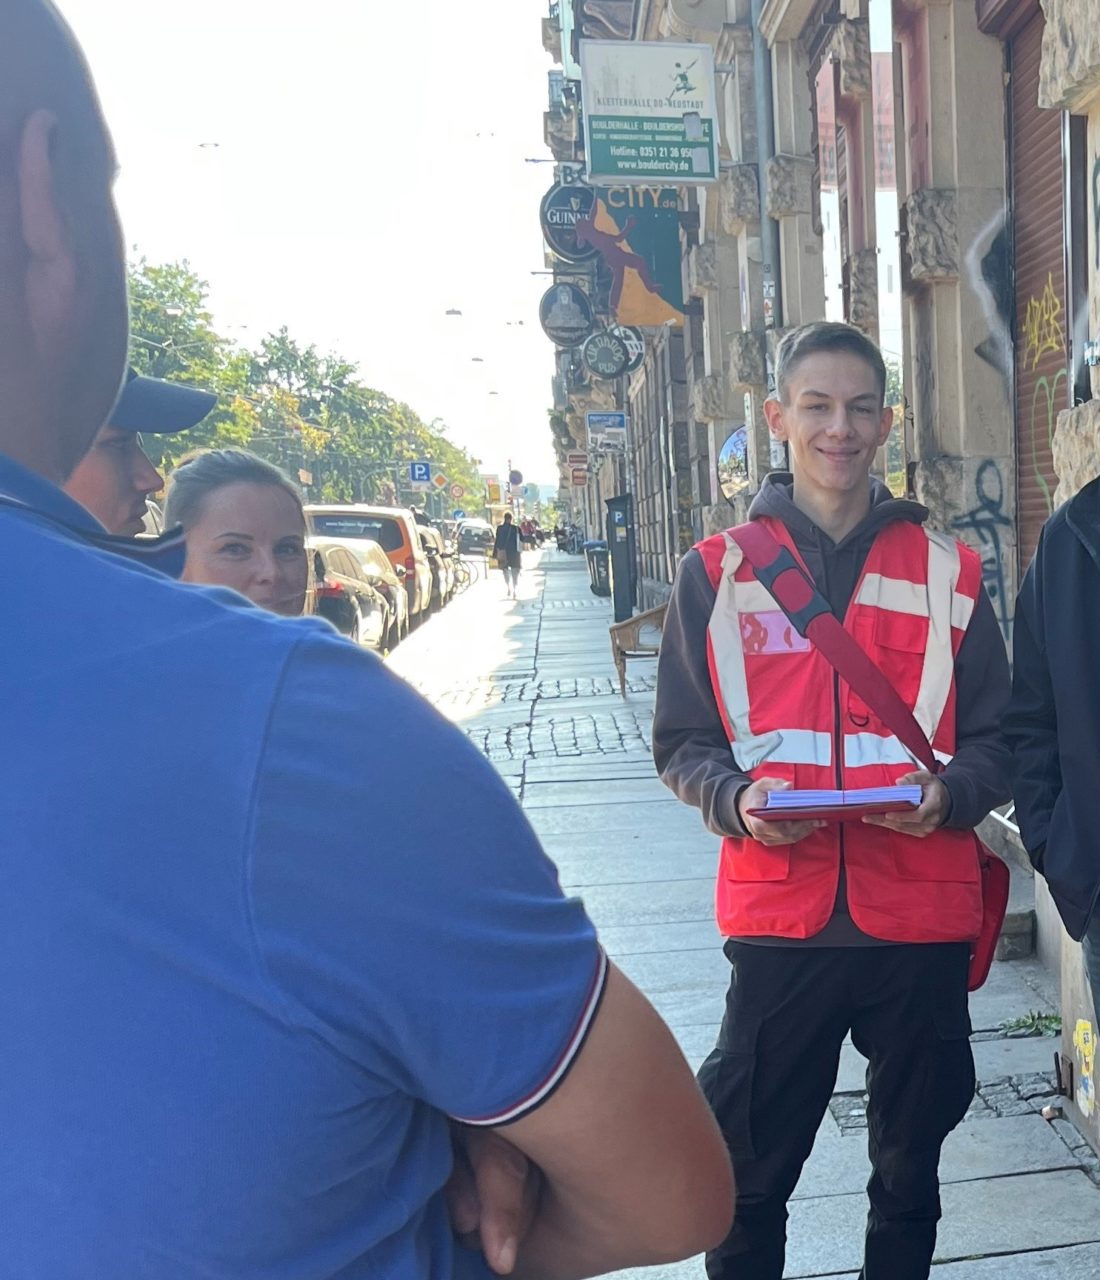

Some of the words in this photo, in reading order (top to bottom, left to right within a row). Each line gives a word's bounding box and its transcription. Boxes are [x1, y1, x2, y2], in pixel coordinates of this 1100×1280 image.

[640, 146, 657, 158] 0351
[659, 147, 668, 157] 21
[617, 159, 689, 173] www.bouldercity.de
